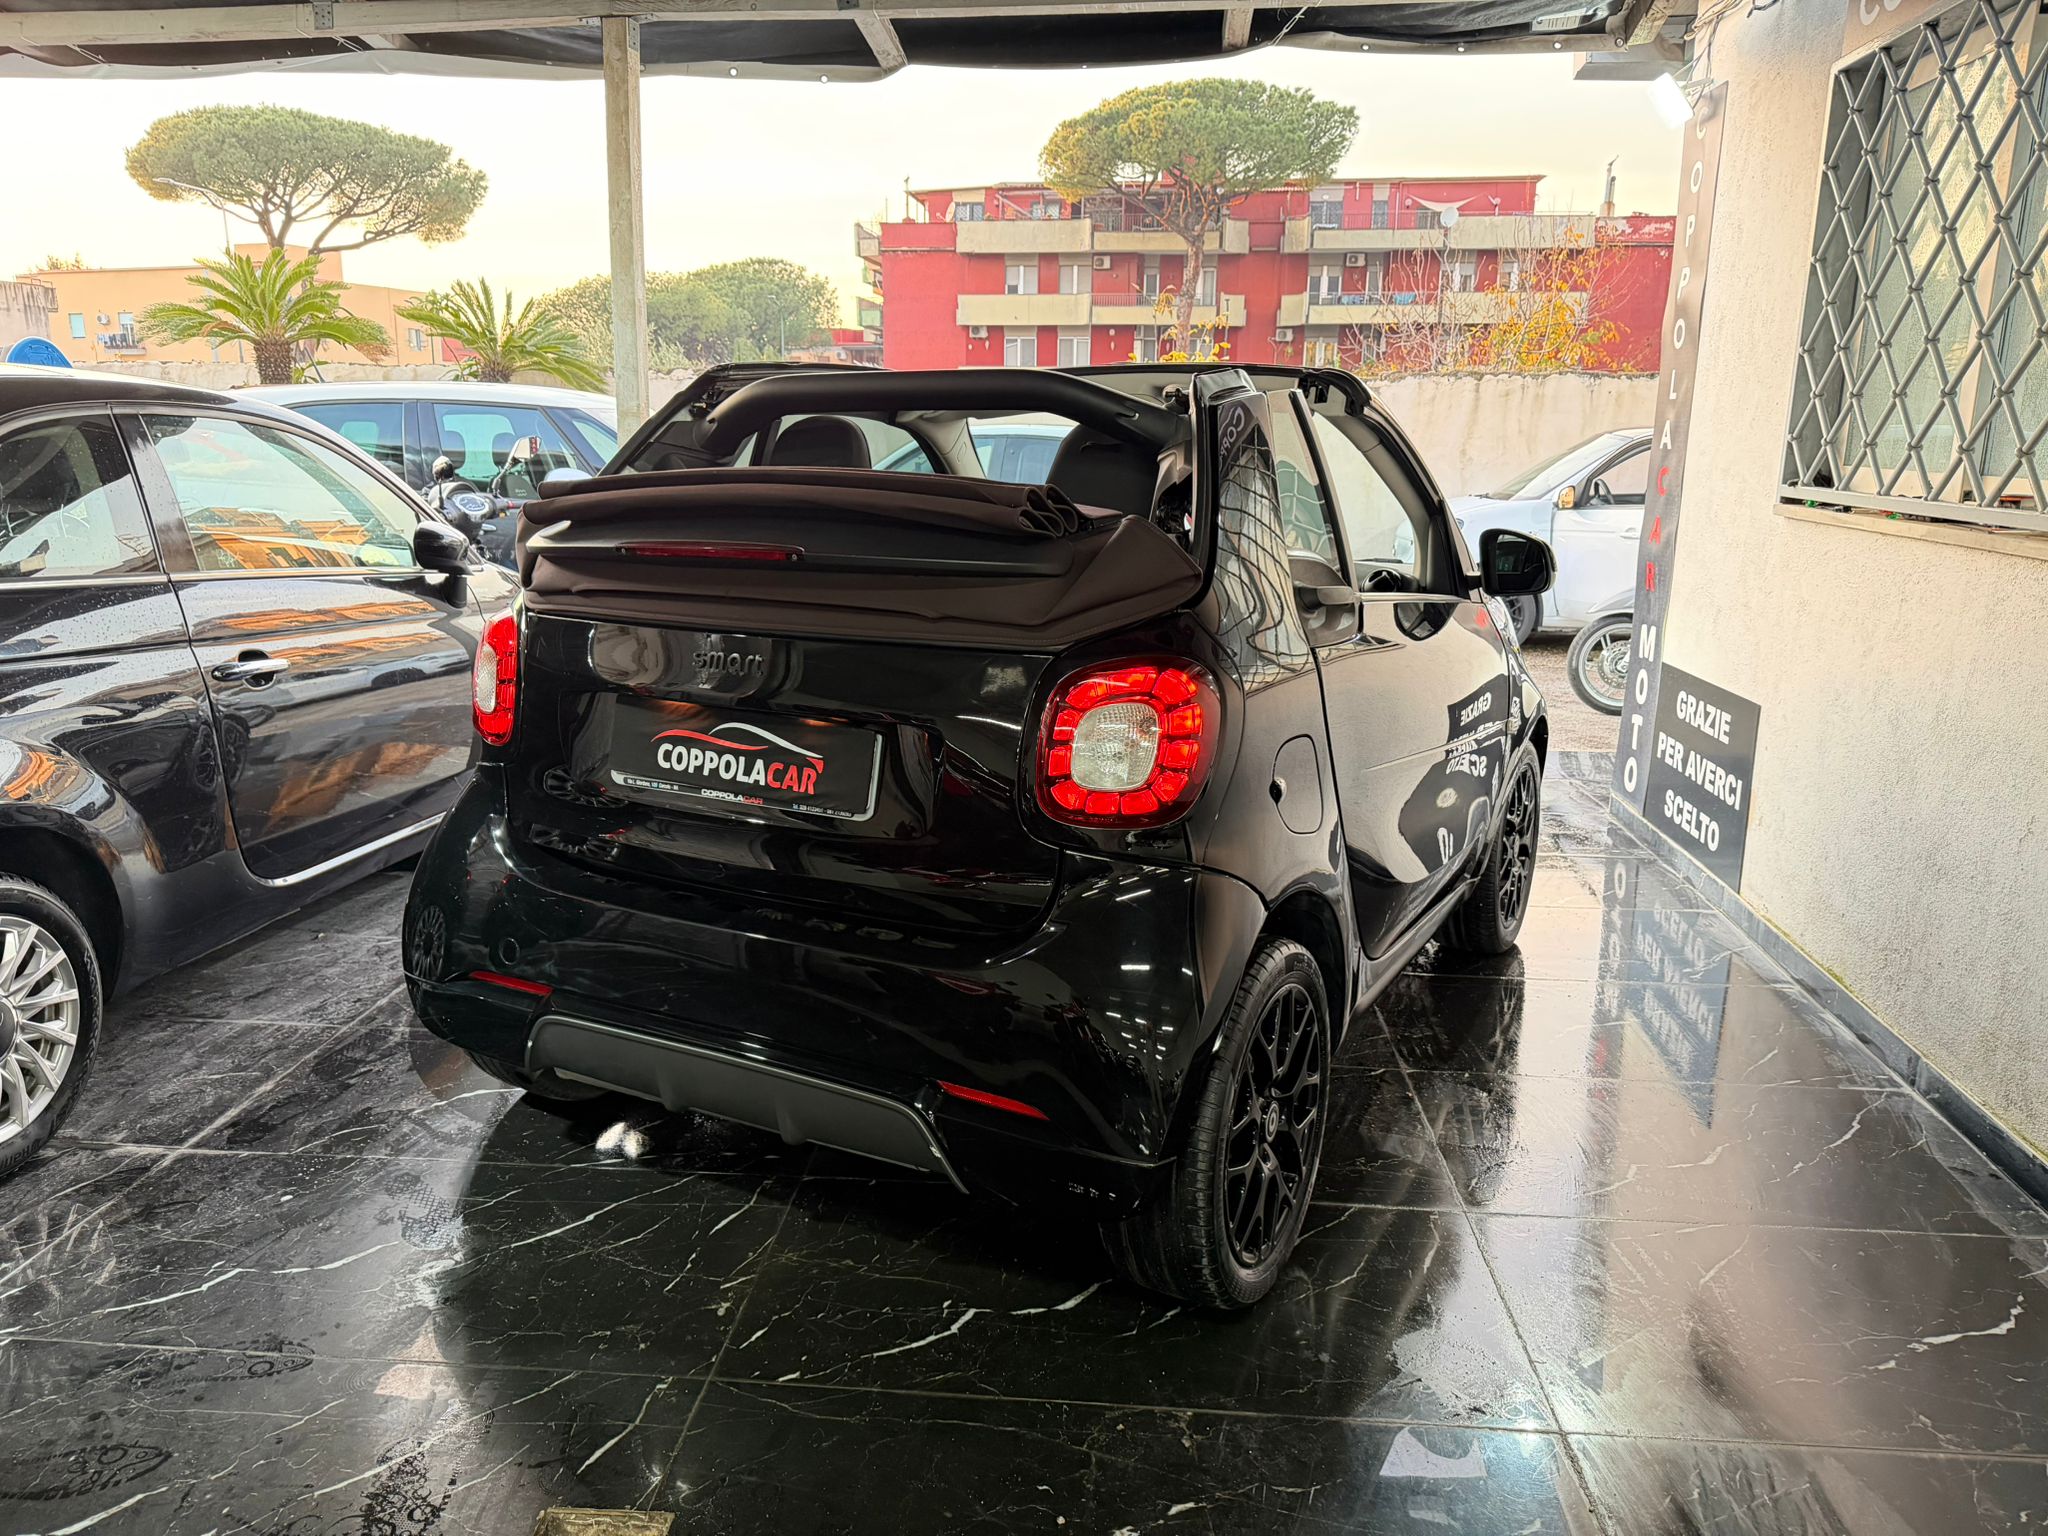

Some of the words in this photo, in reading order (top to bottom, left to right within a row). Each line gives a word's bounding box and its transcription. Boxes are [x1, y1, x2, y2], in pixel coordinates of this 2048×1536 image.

[692, 651, 765, 678] smart
[1624, 624, 1657, 793] MOTO
[1676, 690, 1732, 745] GRAZIE
[657, 742, 823, 795] COPPOLACAR
[1656, 731, 1684, 773] PER
[1685, 750, 1743, 811] AVERCI
[701, 788, 764, 805] COPPOLACAR
[1664, 789, 1720, 852] SCELTO
